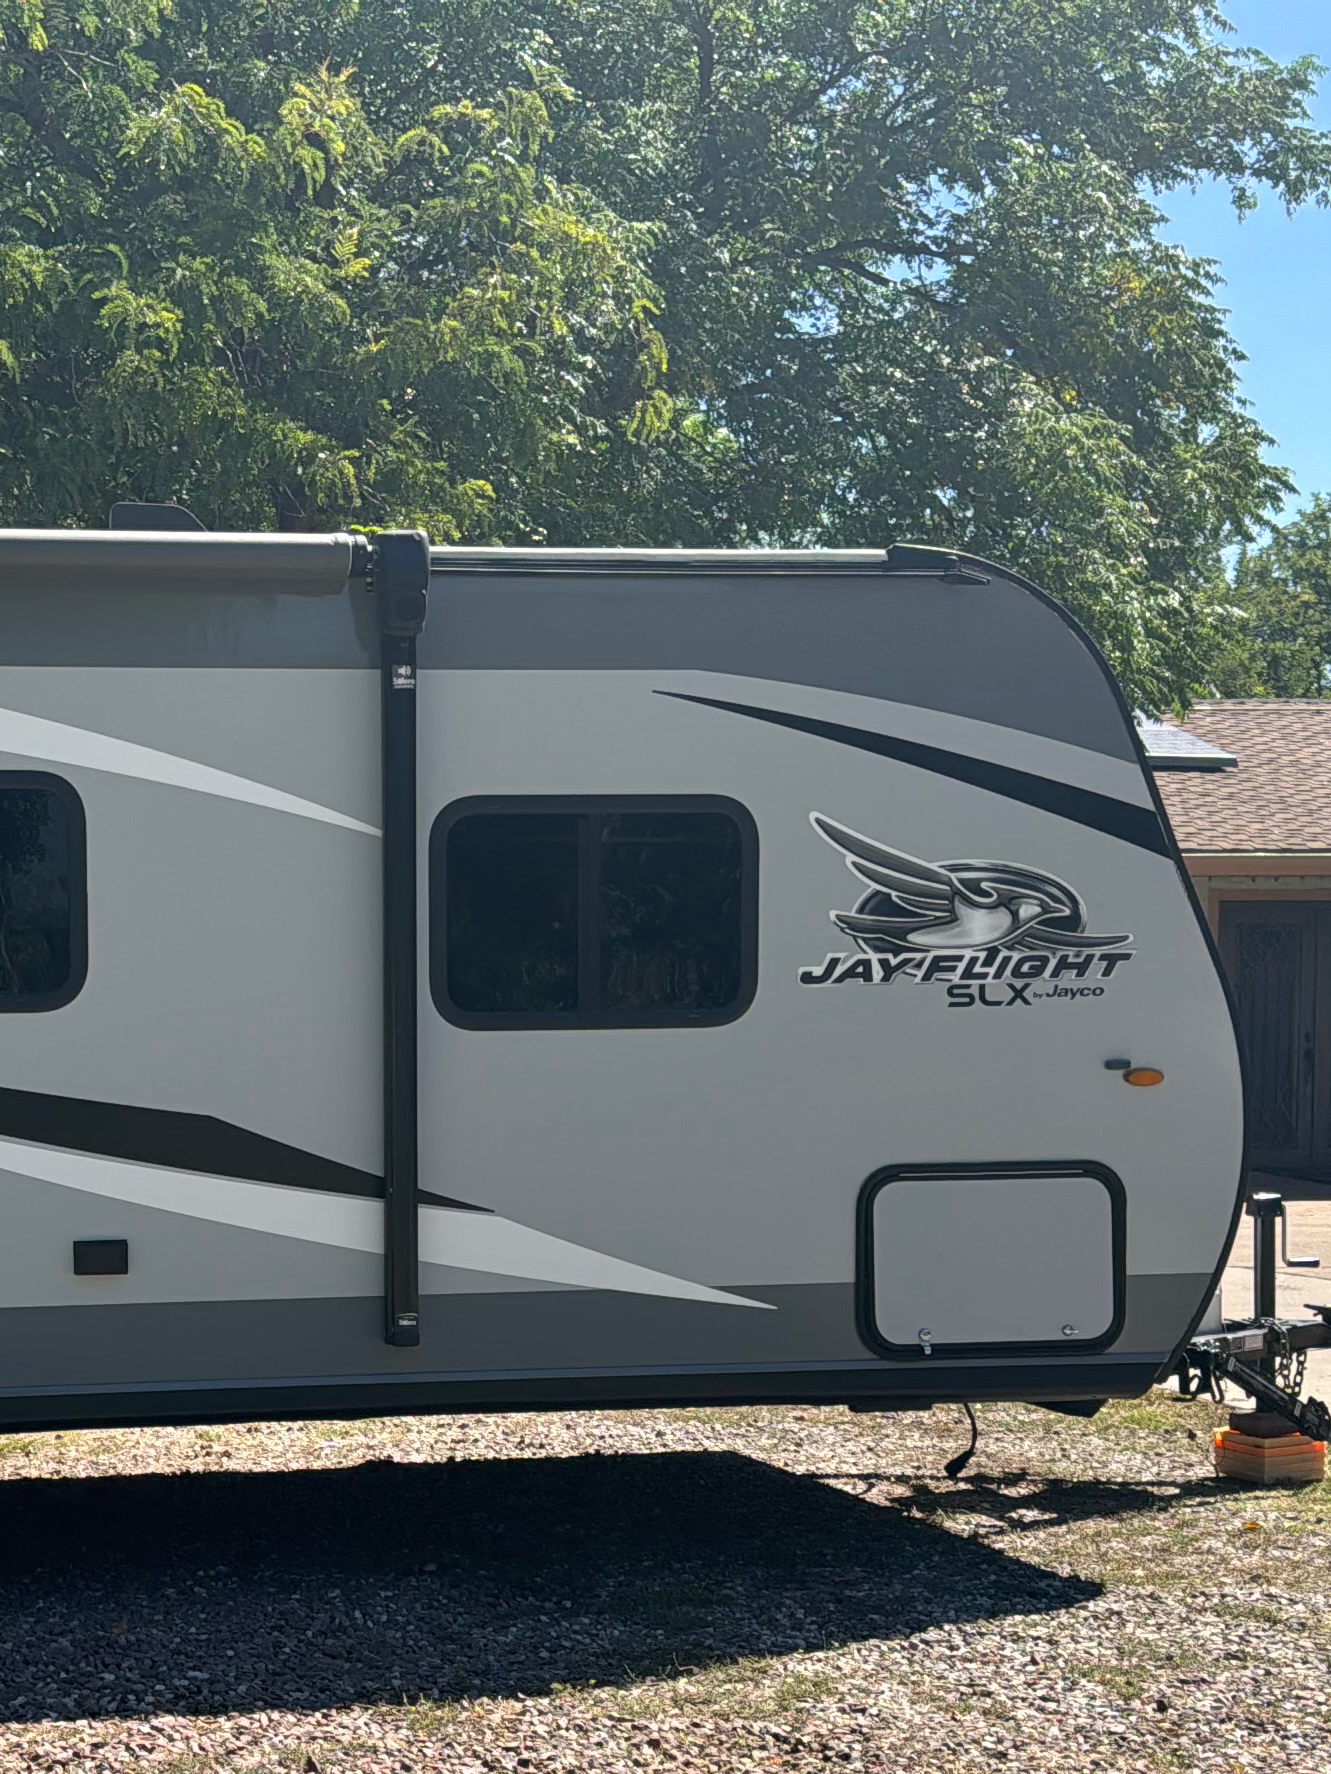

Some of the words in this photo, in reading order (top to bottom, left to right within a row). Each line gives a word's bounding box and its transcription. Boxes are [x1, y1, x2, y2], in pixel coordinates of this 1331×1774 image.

[799, 951, 916, 985] JAY
[920, 951, 1134, 983] FLIGHT
[946, 983, 1033, 1008] SLX
[1033, 991, 1044, 1000] by
[1045, 984, 1105, 1001] Jayco
